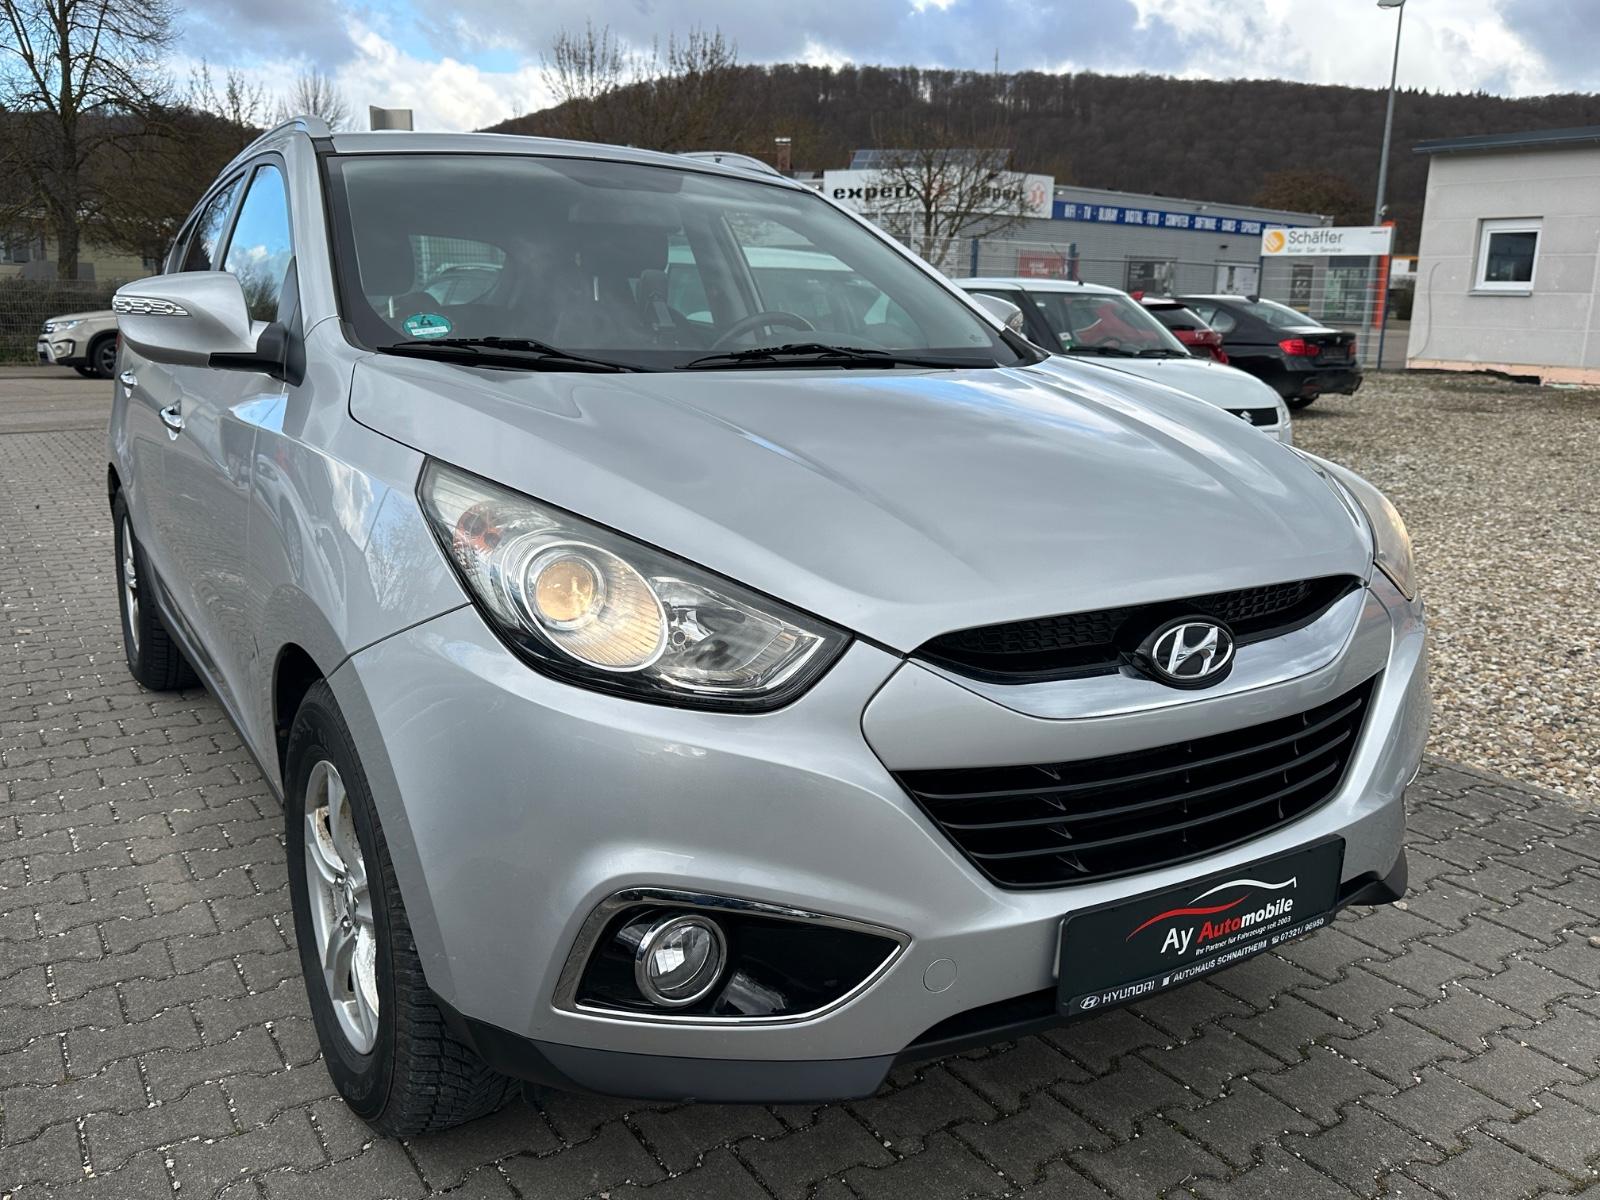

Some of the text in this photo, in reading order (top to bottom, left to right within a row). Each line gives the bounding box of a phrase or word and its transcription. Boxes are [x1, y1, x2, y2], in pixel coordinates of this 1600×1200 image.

[833, 184, 913, 202] expert
[1083, 206, 1092, 220] TV
[1287, 230, 1344, 244] Schäffer
[1160, 898, 1294, 955] Ay Automobile
[1205, 939, 1228, 954] Partner
[1227, 935, 1238, 946] für
[1237, 925, 1267, 941] Fahrzeuge
[1267, 920, 1278, 931] seit
[1277, 915, 1292, 927] 2003
[1102, 980, 1155, 1004] HYUNDAI
[1173, 958, 1216, 983] AUTOHAUS
[1217, 940, 1267, 967] SCHNAITHEIM
